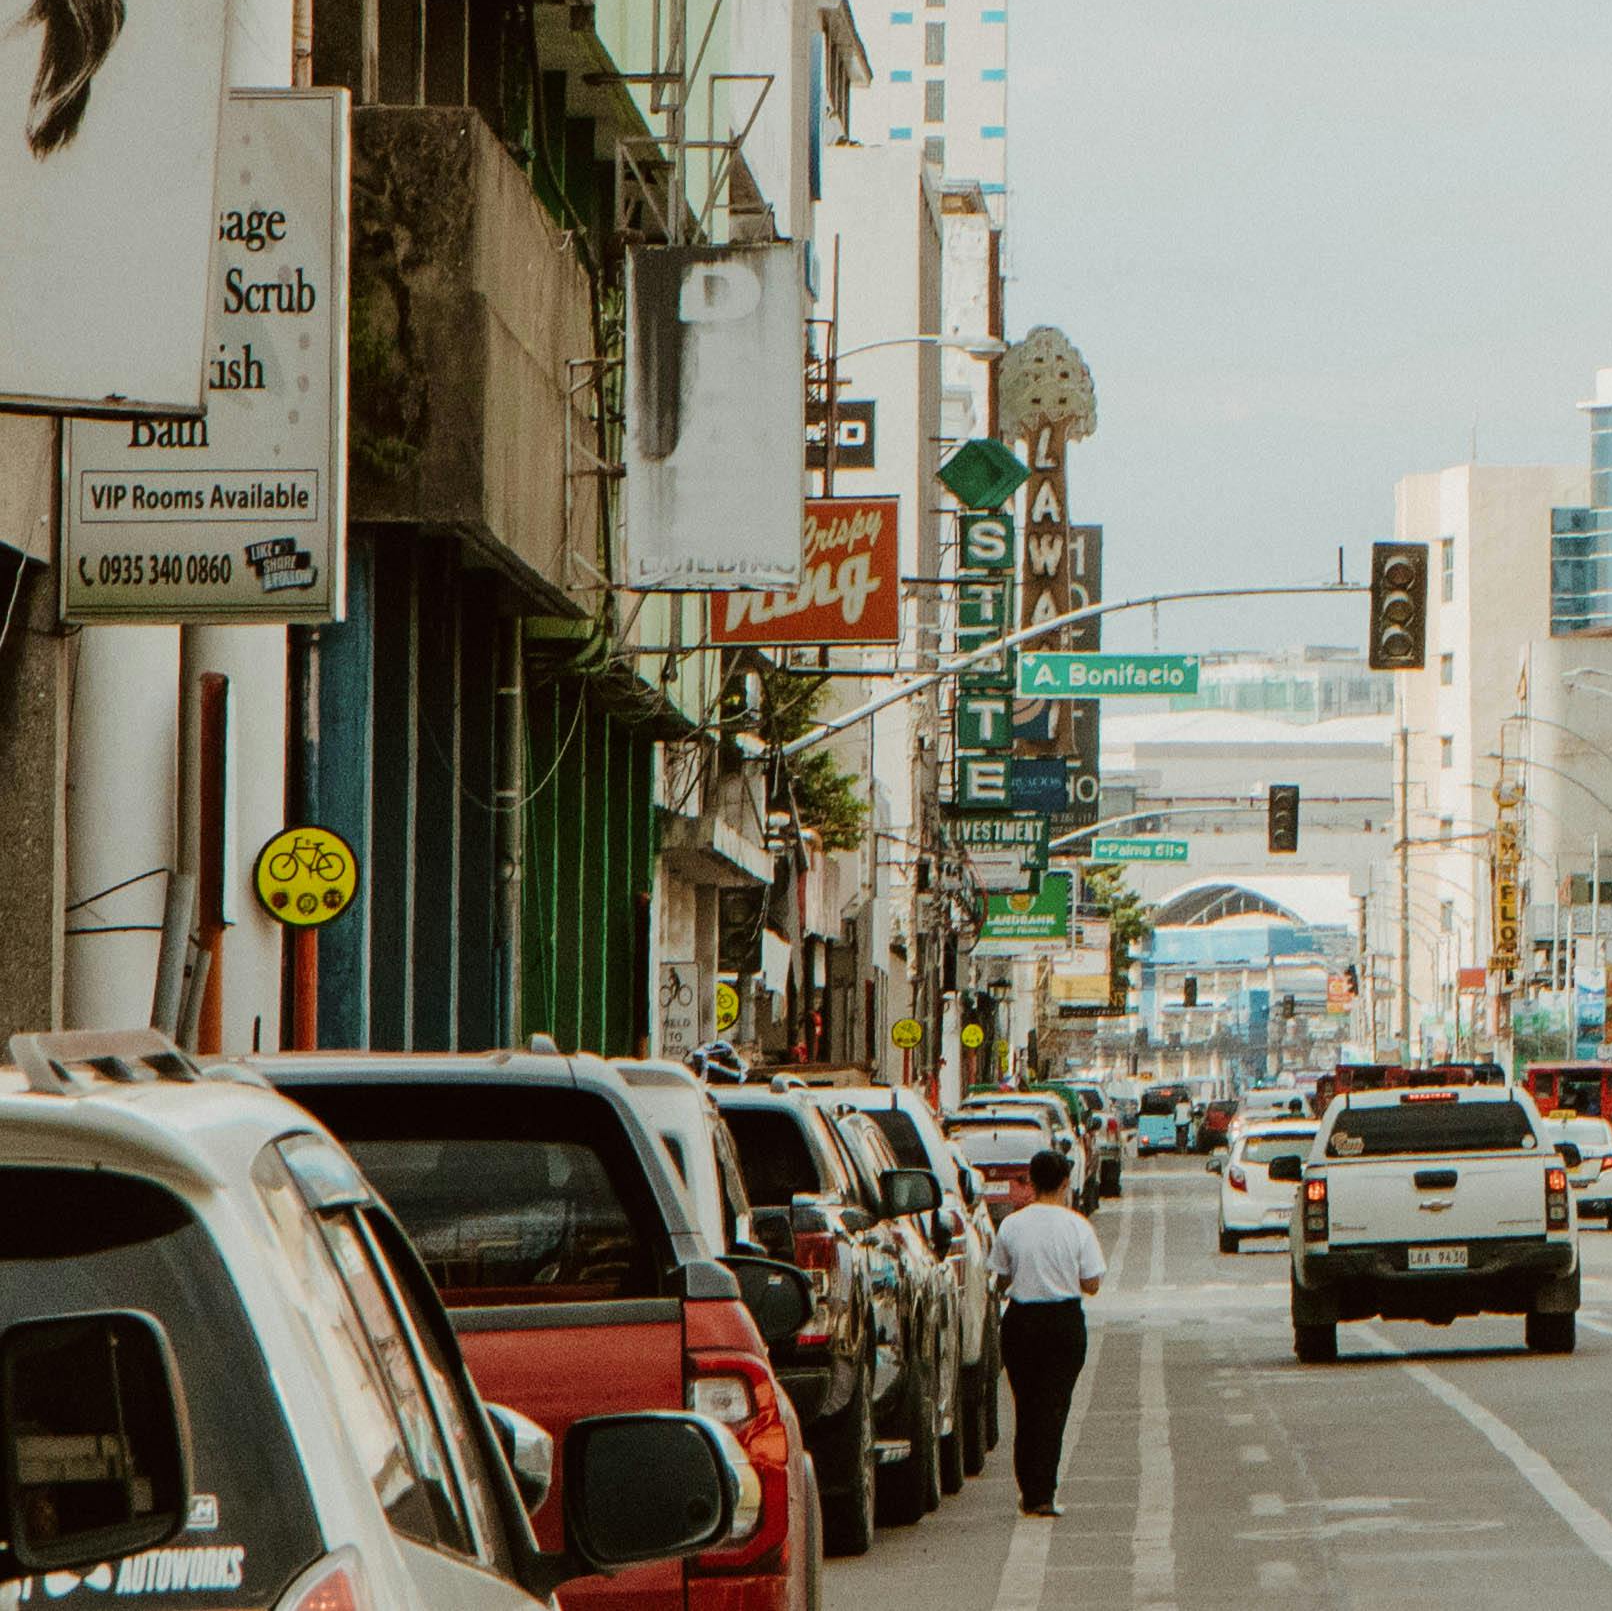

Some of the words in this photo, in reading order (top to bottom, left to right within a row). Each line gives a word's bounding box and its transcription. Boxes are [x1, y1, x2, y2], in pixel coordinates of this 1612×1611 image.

[223, 267, 316, 313] Scrub
[209, 344, 266, 389] ish
[91, 484, 127, 509] VIP
[132, 484, 205, 509] Rooms
[209, 482, 310, 509] Available
[99, 553, 144, 585] 0935
[149, 554, 182, 585] 340
[186, 553, 233, 585] 0860
[1034, 663, 1060, 686] A.
[1069, 661, 1185, 687] Bonifacio
[1107, 843, 1151, 857] Palma
[115, 1545, 245, 1596] AUTOWORKS
